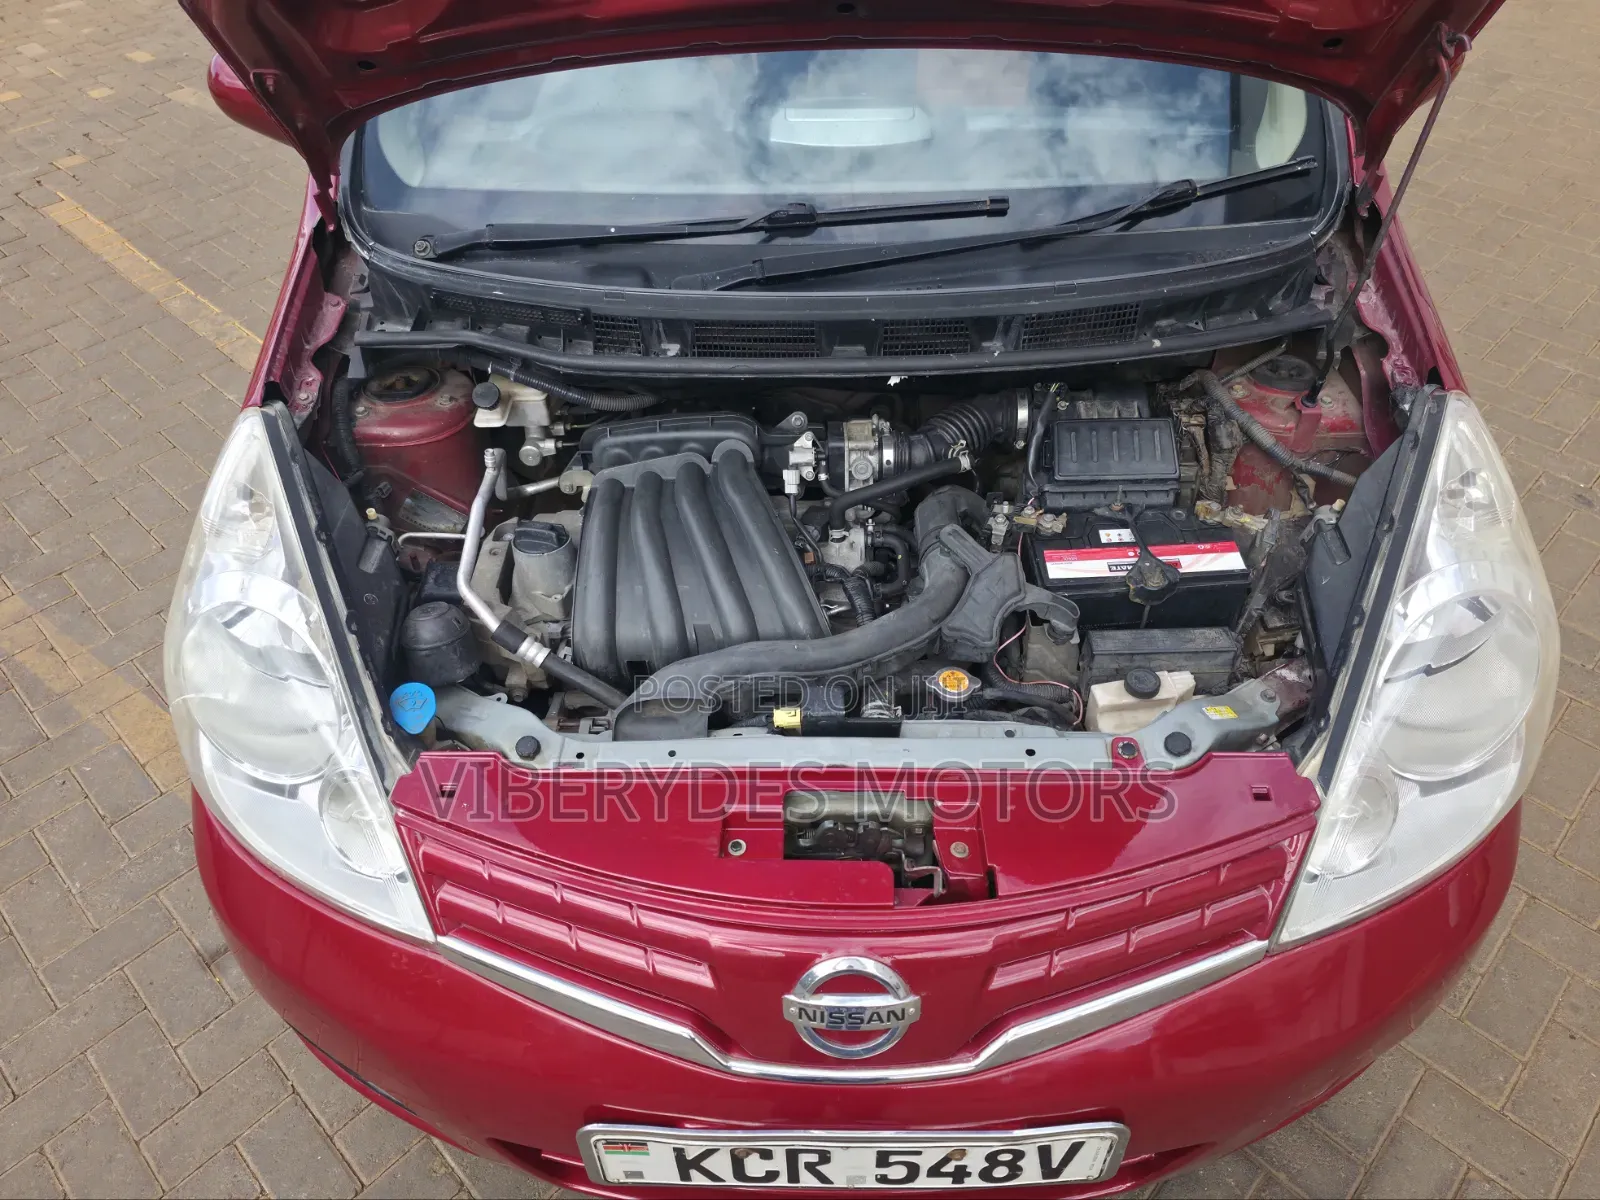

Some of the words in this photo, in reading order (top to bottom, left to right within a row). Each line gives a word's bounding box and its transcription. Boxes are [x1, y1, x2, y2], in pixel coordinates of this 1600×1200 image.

[798, 1007, 906, 1025] NISSAN
[673, 1146, 835, 1186] KCR
[874, 1140, 1087, 1186] 548V
